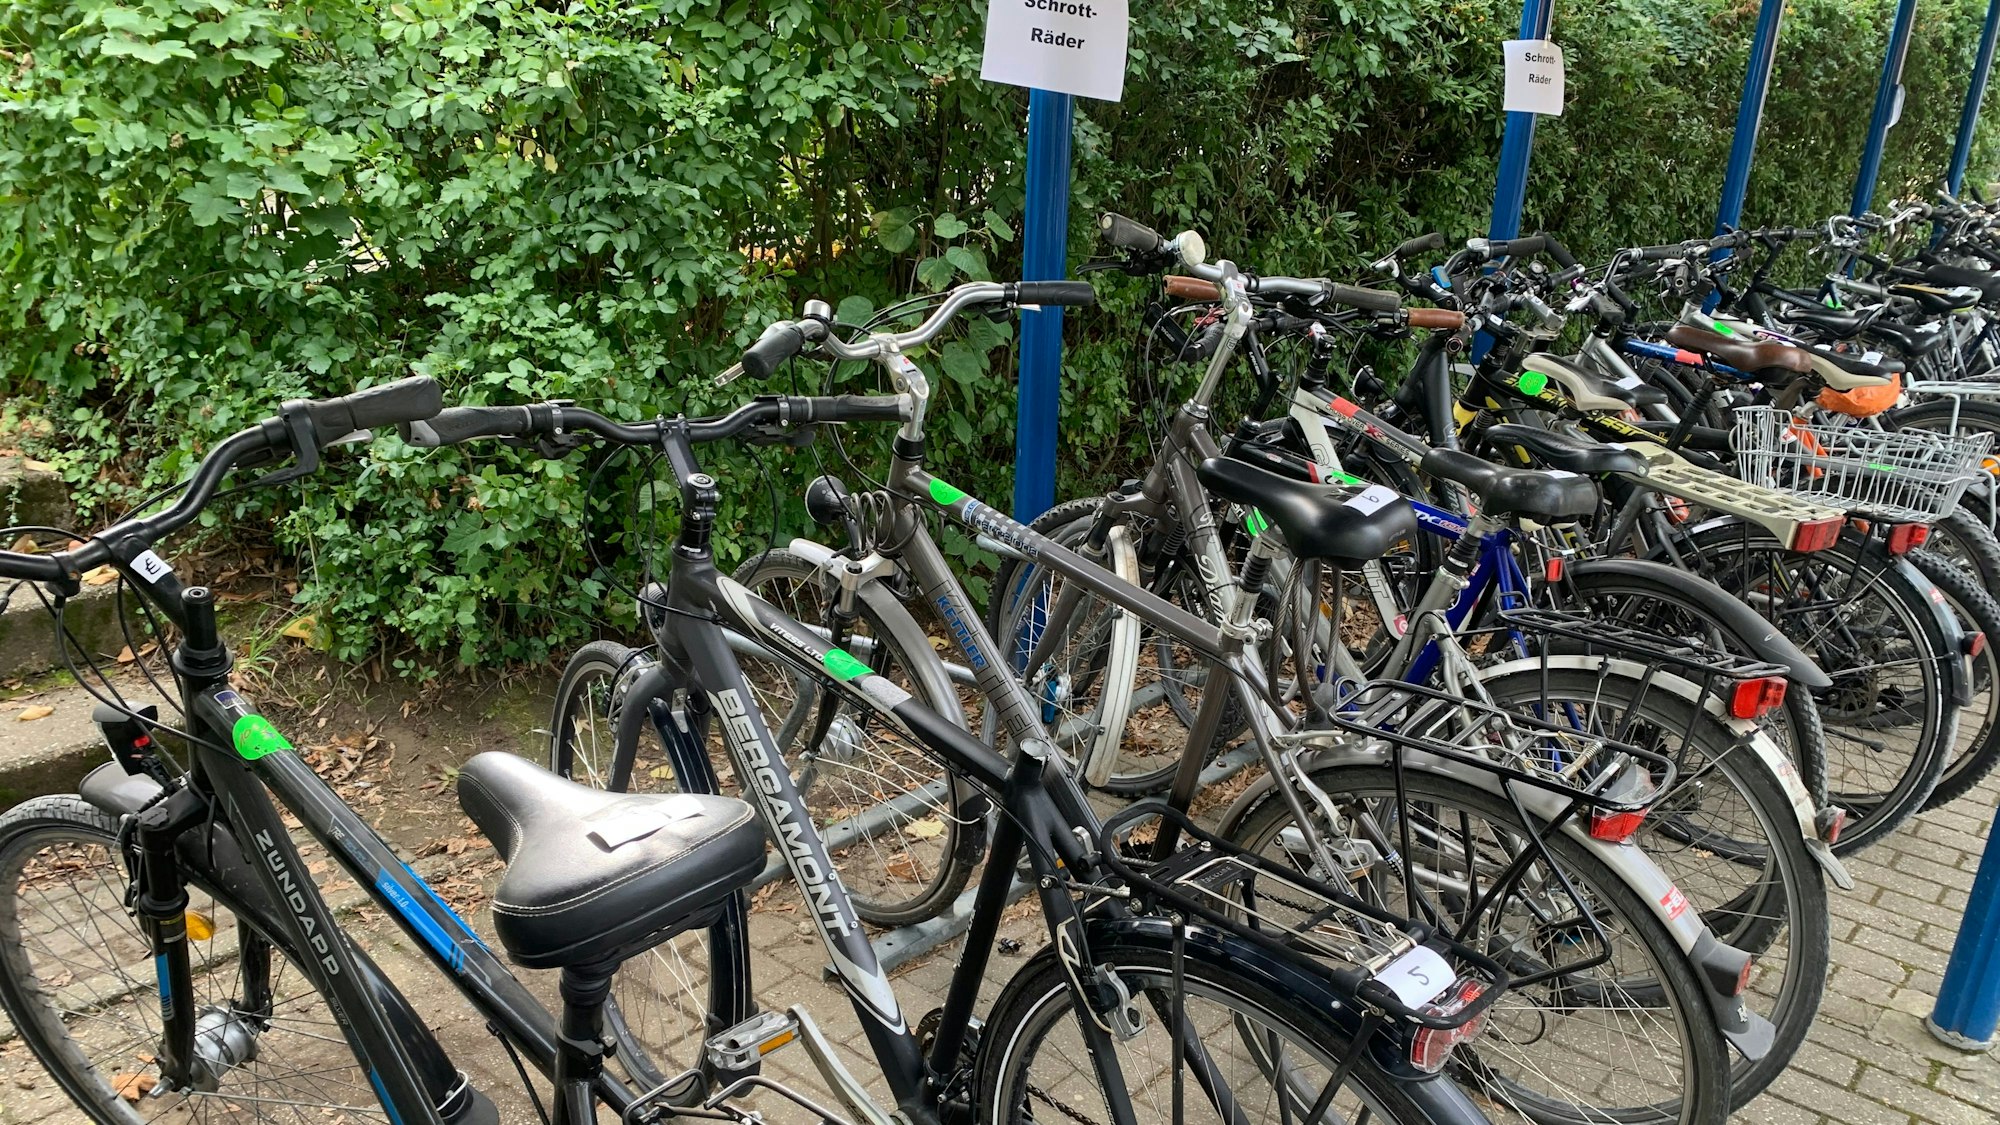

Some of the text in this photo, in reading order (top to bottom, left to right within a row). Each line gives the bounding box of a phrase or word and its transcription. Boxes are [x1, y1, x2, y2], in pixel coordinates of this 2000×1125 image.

[1031, 27, 1085, 49] Räder
[1525, 52, 1556, 64] Schrott-
[1528, 73, 1552, 85] Räder
[769, 622, 806, 648] VITESS
[936, 594, 987, 671] KETTLER
[717, 688, 851, 938] BERGAMONT
[1407, 965, 1430, 986] 5
